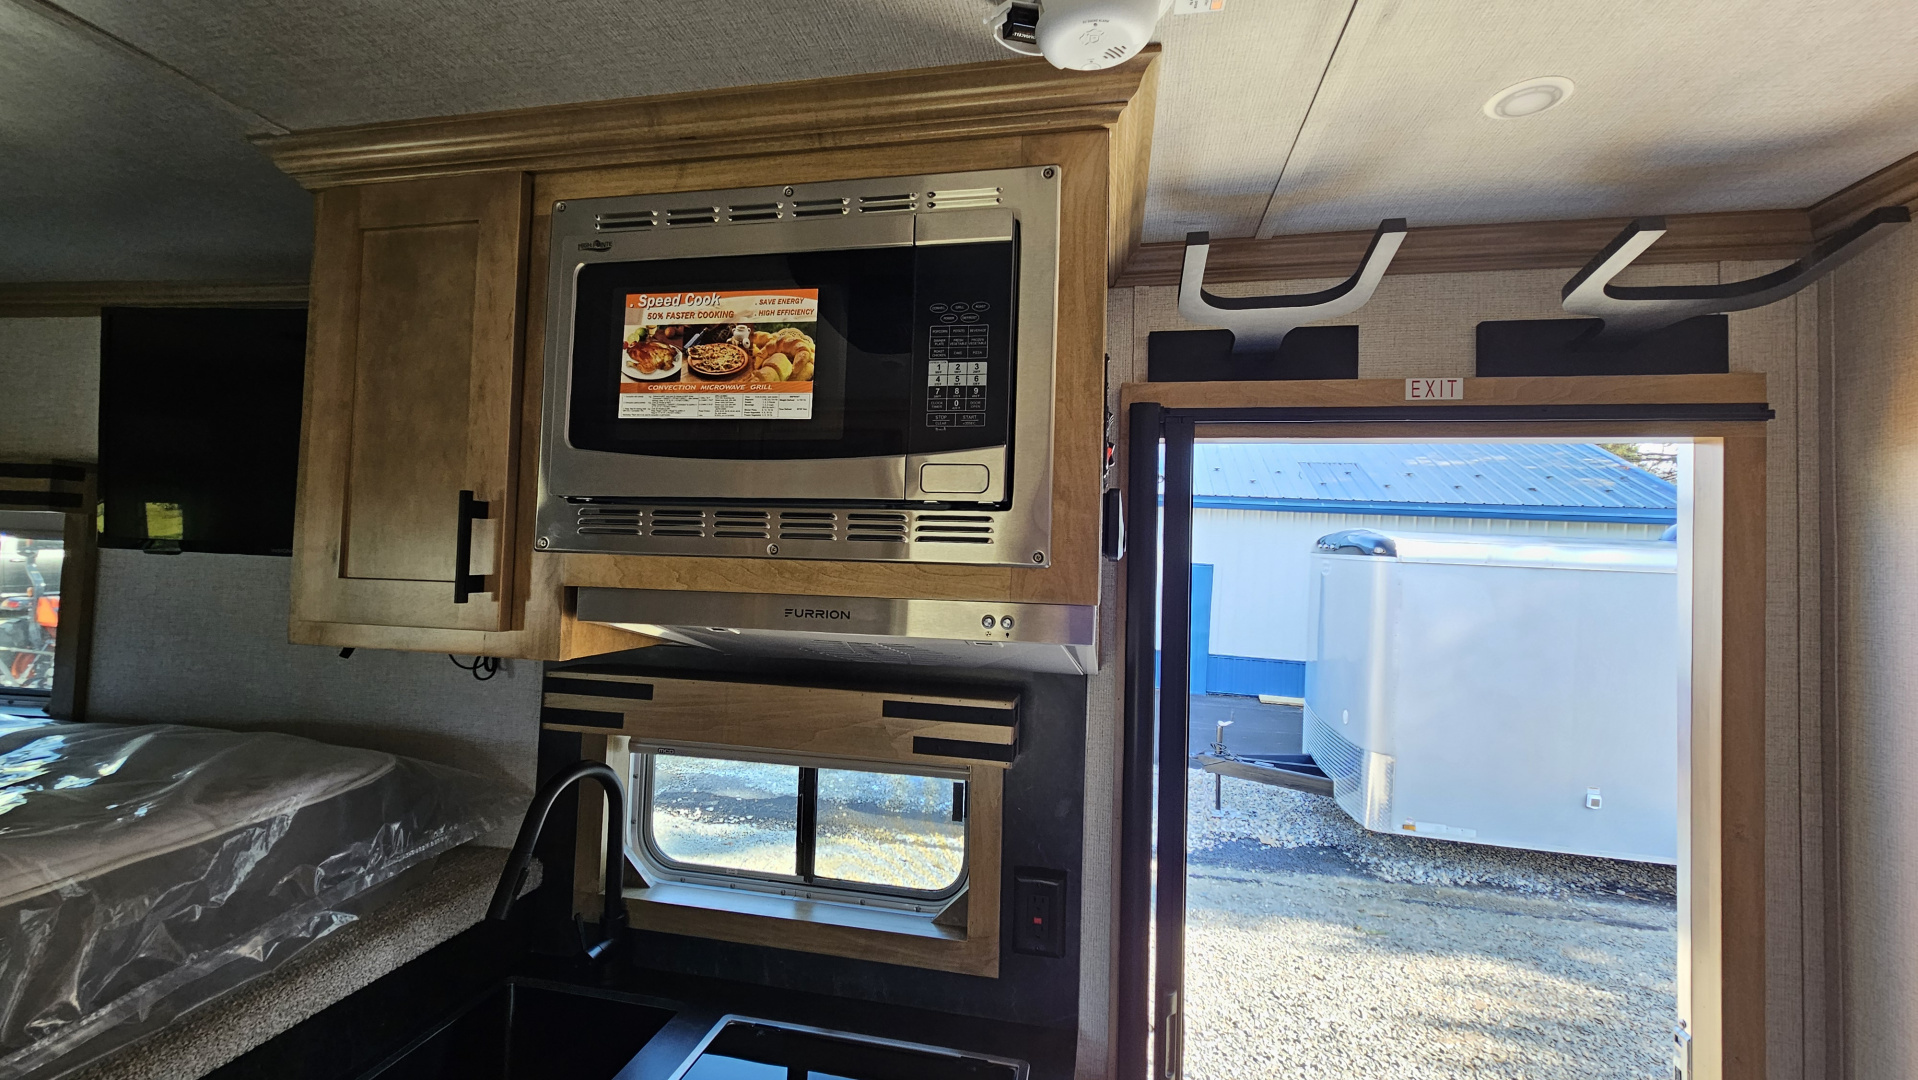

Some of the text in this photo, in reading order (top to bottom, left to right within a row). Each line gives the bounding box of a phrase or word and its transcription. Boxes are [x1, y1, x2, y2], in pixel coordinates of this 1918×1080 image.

[638, 291, 721, 310] Speed Cook
[777, 297, 805, 305] ENERGY
[647, 310, 735, 320] 50% FASTER COOKING
[758, 308, 815, 317] HIGH EFFICIENCY
[1411, 379, 1457, 398] EXIT
[784, 608, 851, 620] FURRION
